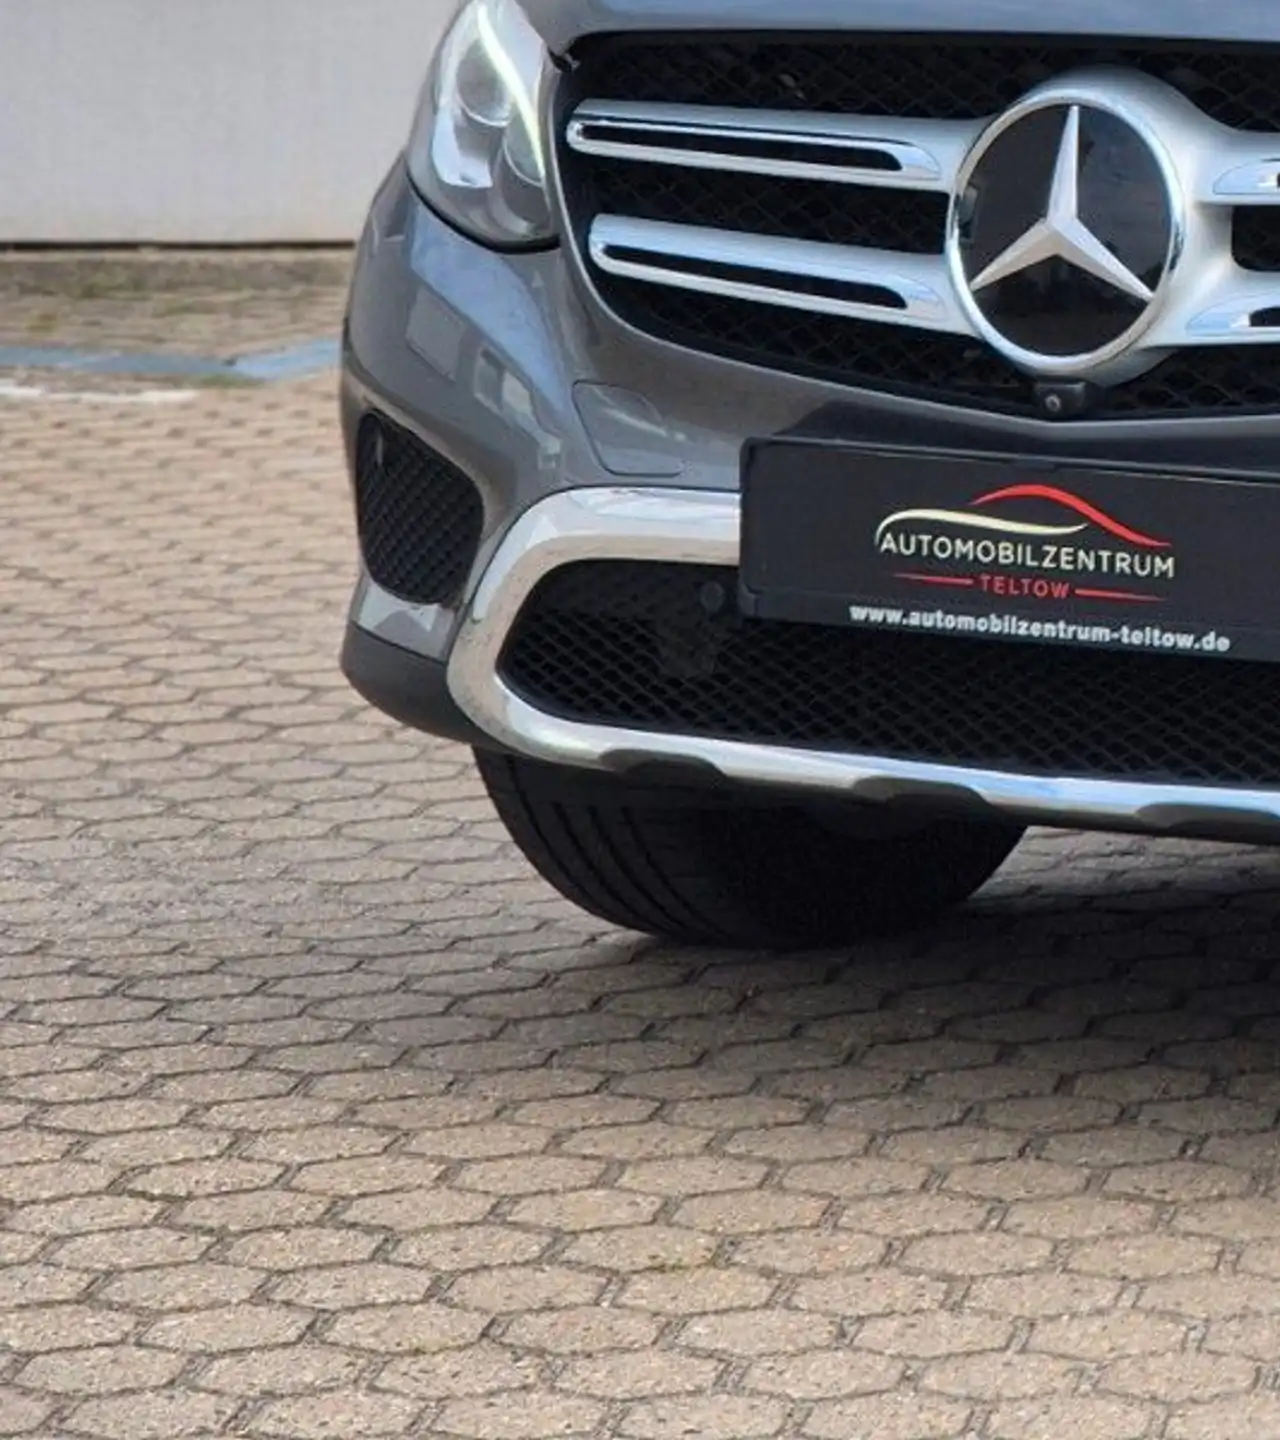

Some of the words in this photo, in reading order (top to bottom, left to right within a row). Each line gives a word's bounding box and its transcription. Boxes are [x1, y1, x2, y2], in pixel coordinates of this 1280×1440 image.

[879, 532, 1175, 579] AUTOMOBILZENTRUM
[978, 573, 1071, 600] TELTOW
[848, 602, 1232, 653] www.automobilzentrum-teltow.de
